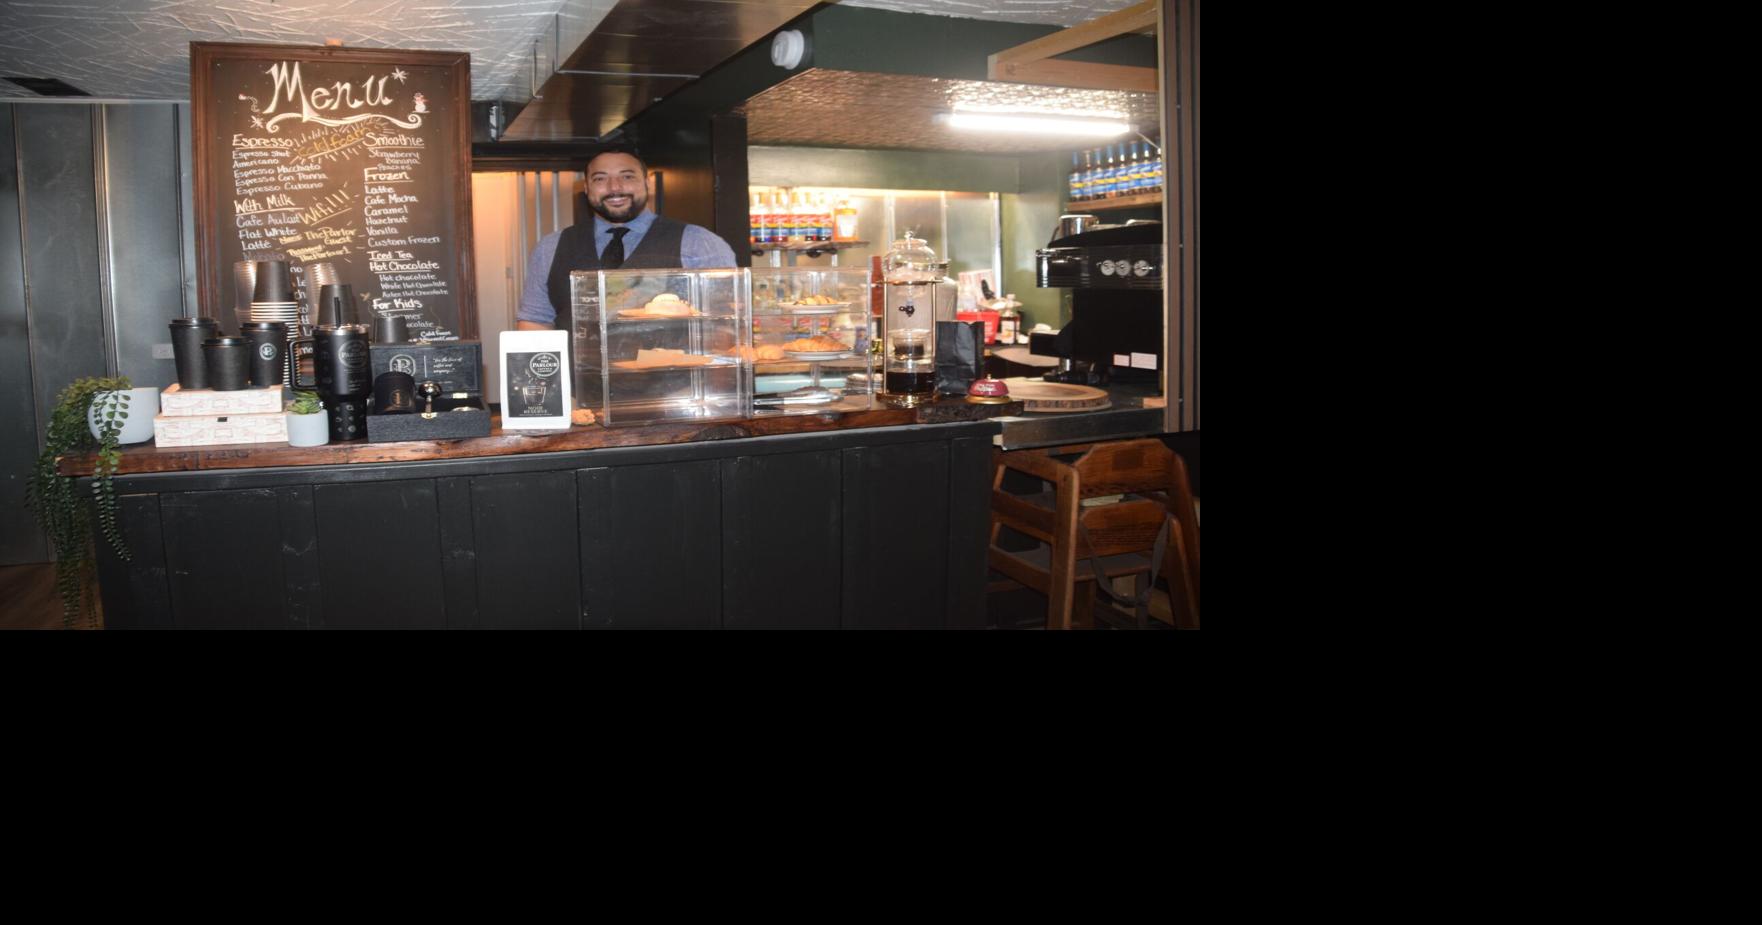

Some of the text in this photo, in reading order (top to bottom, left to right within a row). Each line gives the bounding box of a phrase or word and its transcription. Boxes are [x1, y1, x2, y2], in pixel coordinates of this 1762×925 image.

[263, 61, 393, 122] Menu
[232, 134, 293, 148] Espresso
[362, 132, 424, 147] Smoothie
[232, 150, 269, 160] Espresso
[368, 148, 420, 159] Strawberry
[233, 159, 279, 169] Americano
[233, 163, 321, 179] Espresso Macchiato
[364, 166, 410, 181] Frozen
[235, 172, 328, 187] Espresso Con Panna
[236, 182, 324, 195] Espresso Cubano
[364, 185, 395, 195] Latte
[234, 194, 295, 214] With Milk
[364, 194, 419, 205] Cafe Mocha
[364, 205, 409, 217] Caramel
[365, 215, 408, 226] Hazelnut
[239, 227, 298, 240] Flat White
[366, 226, 399, 236] Vanilla
[367, 235, 440, 248] Custom Frozen
[366, 250, 414, 260] Iced Tea
[369, 260, 440, 271] Hot Chocolate
[372, 298, 423, 310] For Kids
